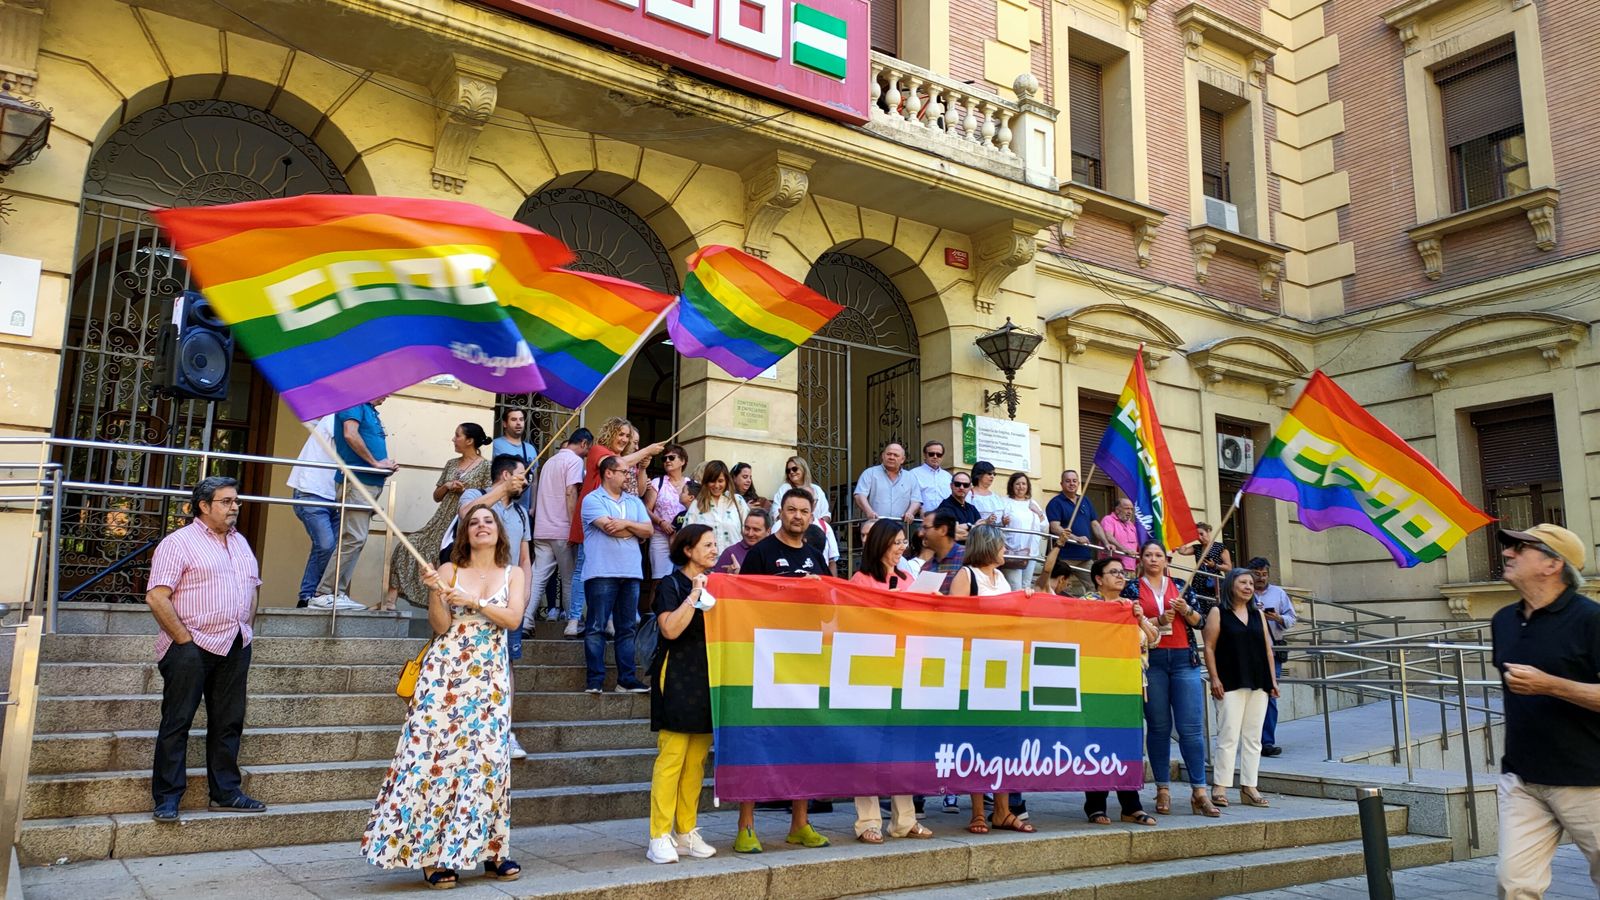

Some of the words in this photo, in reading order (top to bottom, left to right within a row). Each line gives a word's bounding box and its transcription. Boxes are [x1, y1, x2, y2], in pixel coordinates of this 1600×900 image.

[1280, 428, 1453, 553] CCOO
[752, 628, 1024, 711] CCOO
[935, 739, 1128, 790] #OrgulloDeSer
